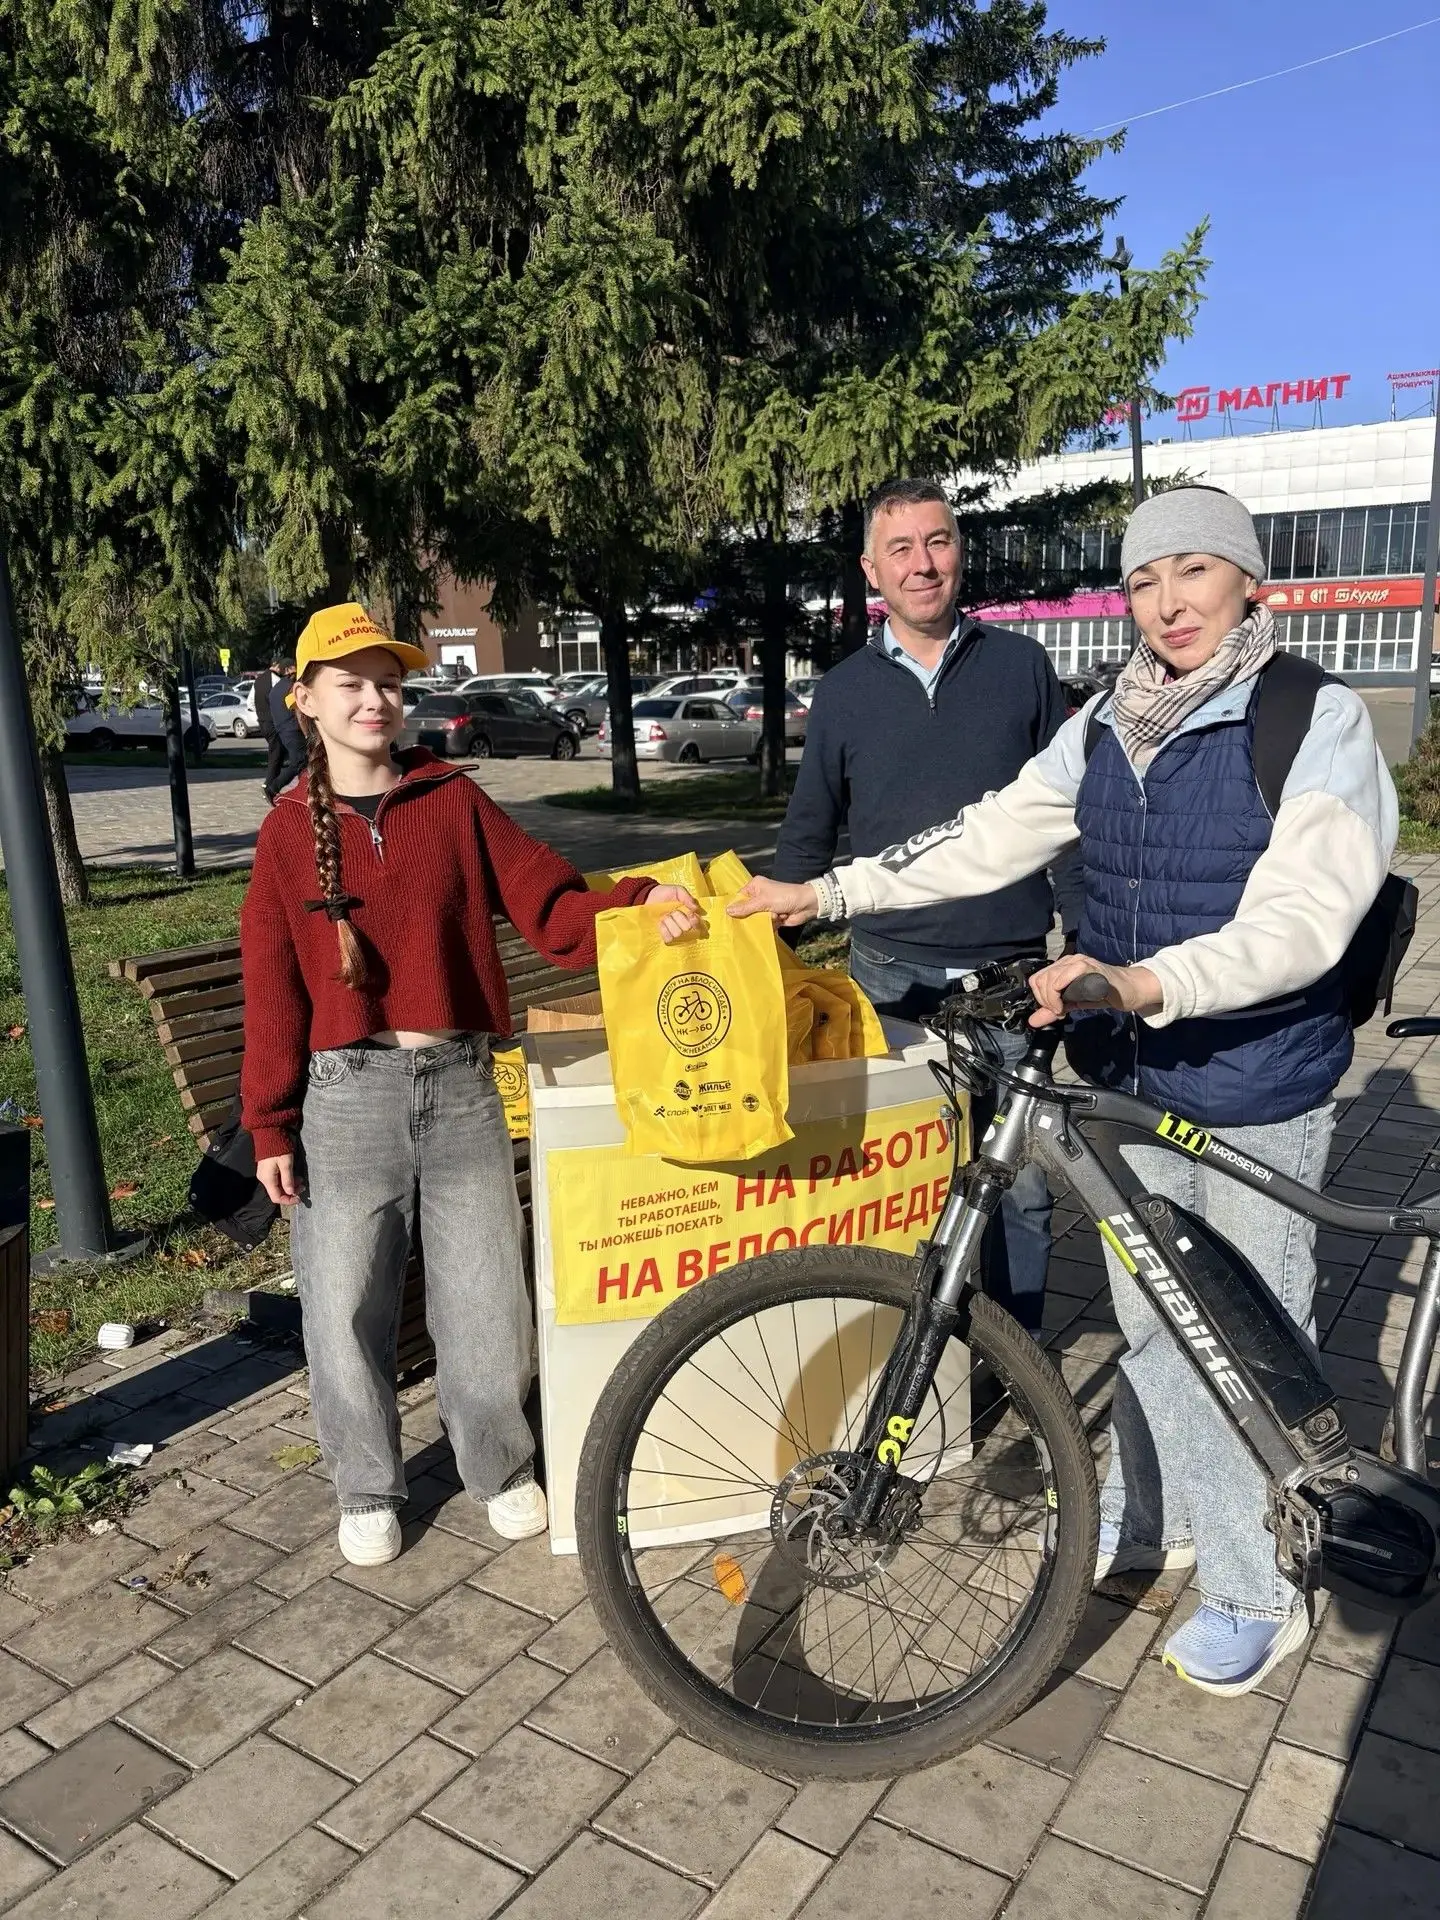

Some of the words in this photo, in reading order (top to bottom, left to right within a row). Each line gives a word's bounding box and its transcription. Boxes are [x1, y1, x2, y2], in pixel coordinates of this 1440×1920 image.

[1217, 373, 1351, 413] МАГНИТ
[351, 616, 367, 624] НА
[328, 635, 342, 646] НА
[678, 977, 690, 985] НА
[736, 1164, 796, 1212] НА
[808, 1118, 951, 1194] РАБОТУ
[1207, 1140, 1274, 1185] HARDSEVEN
[618, 1215, 637, 1228] ТЫ
[640, 1198, 721, 1224] РАБОТАЕШЬ,
[621, 1187, 689, 1210] НЕВАЖНО,
[692, 1180, 719, 1196] КЕМ
[579, 1239, 598, 1252] ТЫ
[601, 1226, 663, 1249] МОЖЕШЬ
[666, 1214, 723, 1236] ПОЕХАТЬ
[597, 1257, 663, 1304] НА
[1107, 1212, 1254, 1404] HAIBIKE
